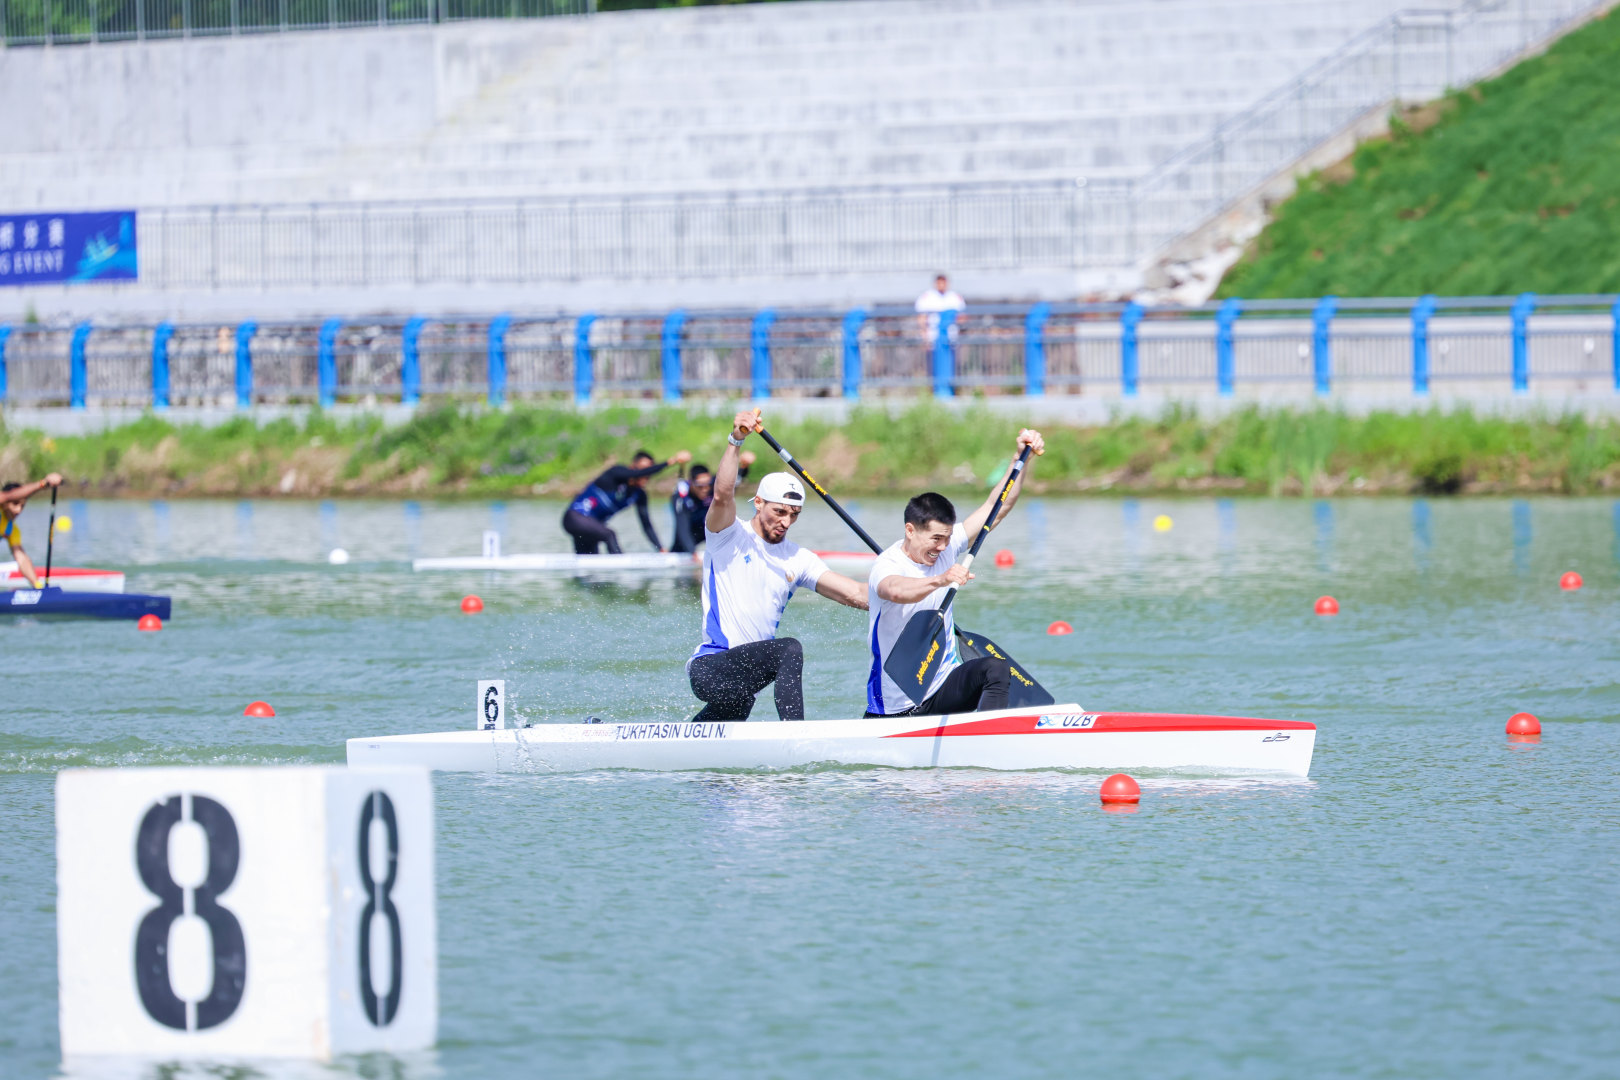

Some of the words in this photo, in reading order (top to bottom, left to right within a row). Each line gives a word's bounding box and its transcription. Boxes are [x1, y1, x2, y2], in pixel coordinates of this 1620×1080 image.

[13, 248, 64, 274] EVENT
[484, 686, 499, 722] 6
[616, 724, 682, 740] TUKHTASIN
[683, 723, 714, 739] UGLI
[714, 723, 727, 739] N.
[134, 793, 248, 1032] 8
[358, 789, 403, 1028] 8
